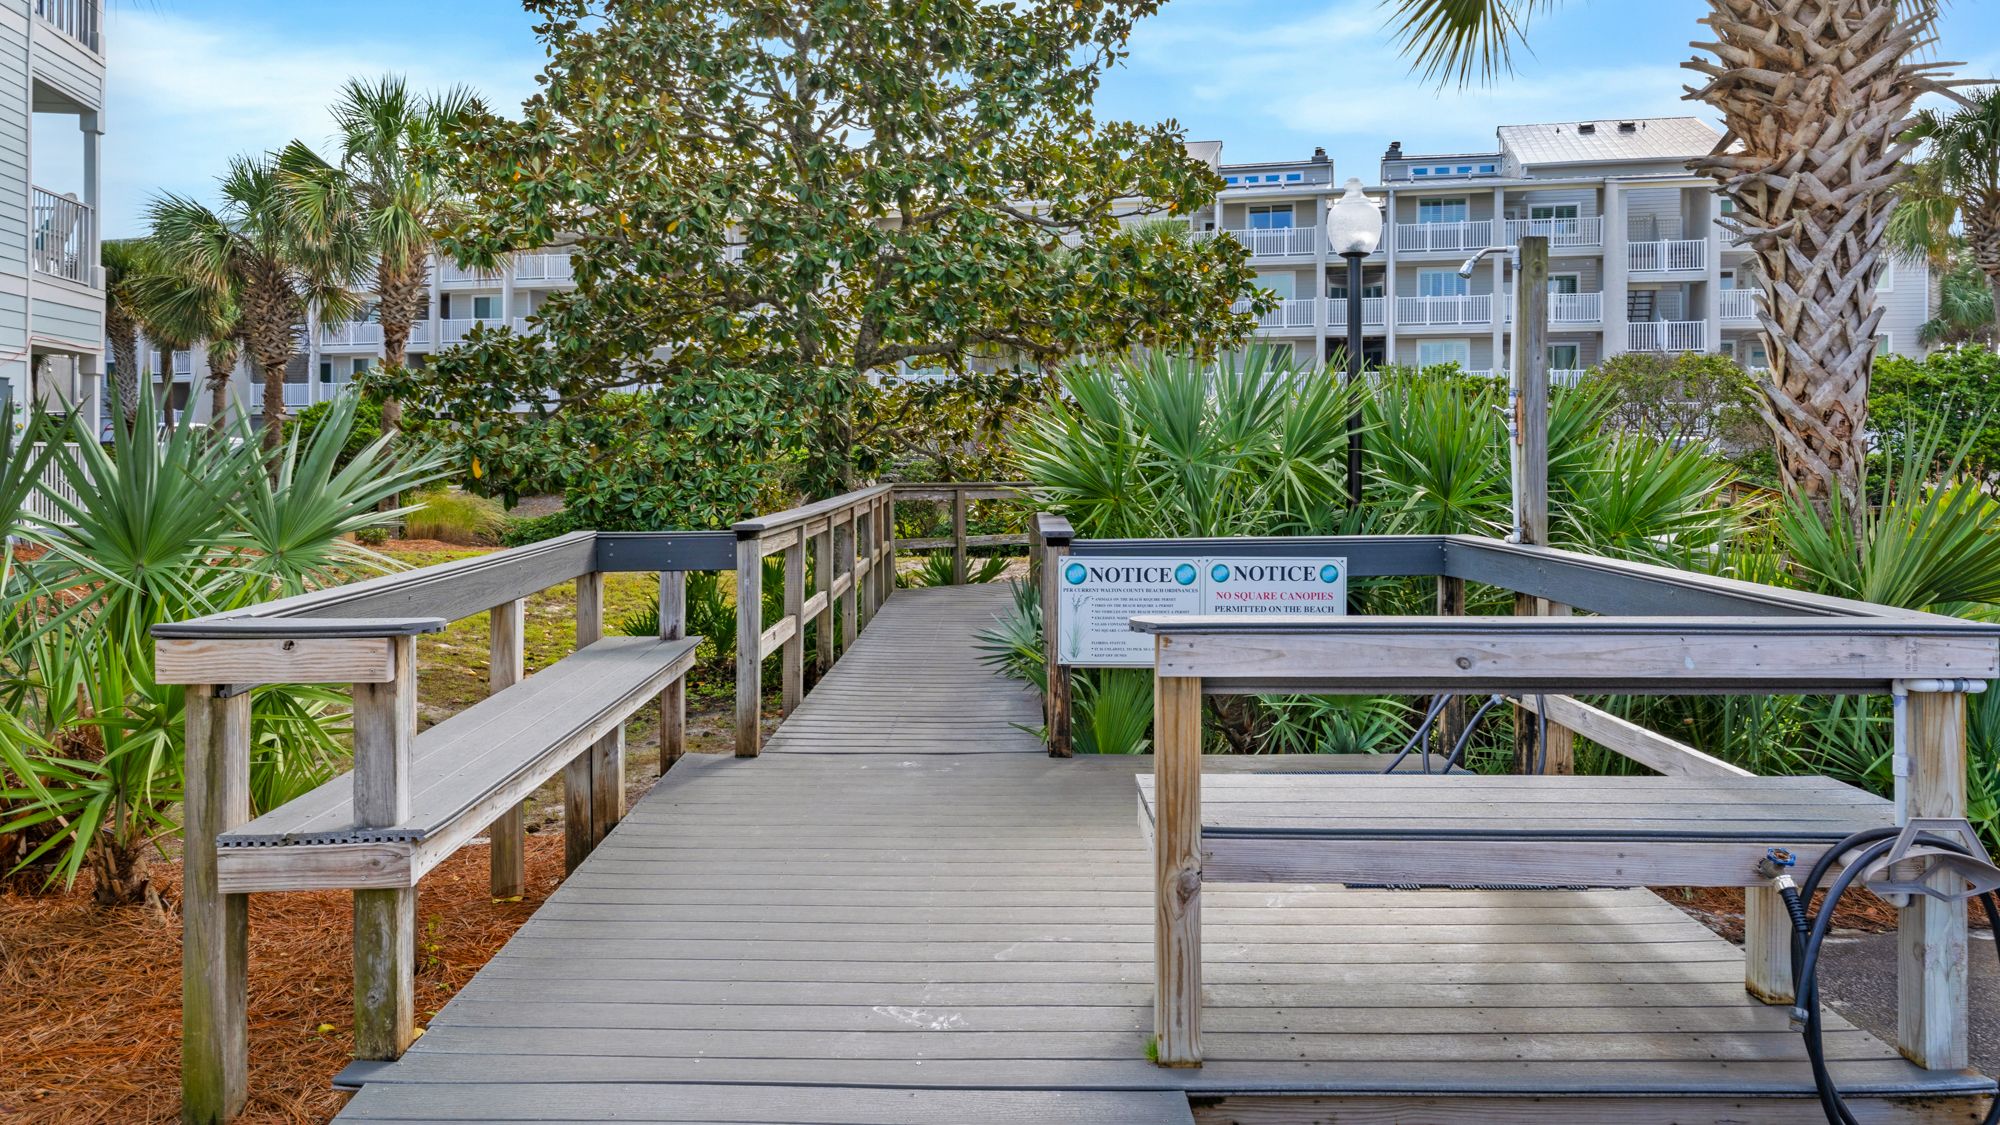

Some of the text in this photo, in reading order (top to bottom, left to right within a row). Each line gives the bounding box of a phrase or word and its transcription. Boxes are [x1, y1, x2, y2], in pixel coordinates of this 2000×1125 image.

[1090, 567, 1172, 583] NOTICE
[1234, 566, 1316, 581] NOTICE
[1216, 592, 1334, 601] NO SQUARE CANOPIES
